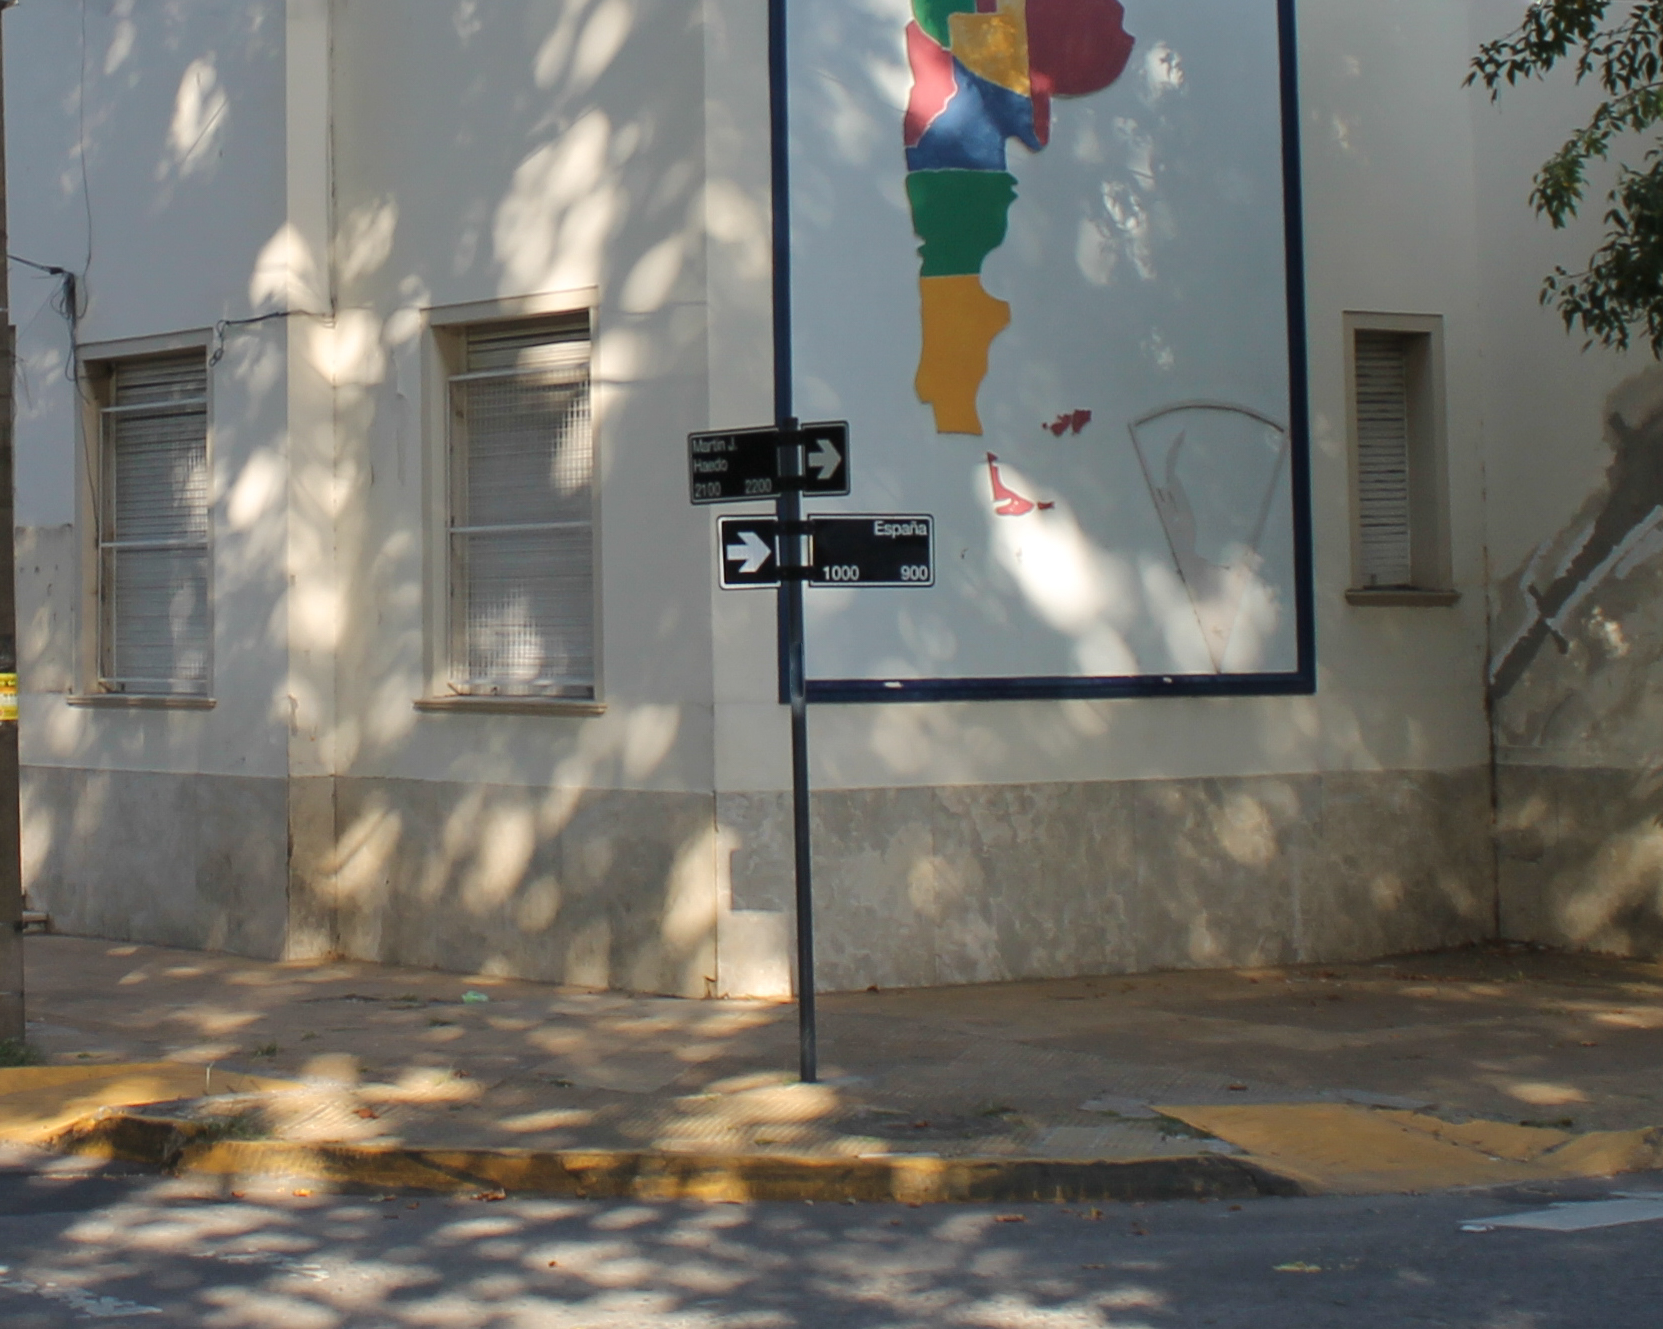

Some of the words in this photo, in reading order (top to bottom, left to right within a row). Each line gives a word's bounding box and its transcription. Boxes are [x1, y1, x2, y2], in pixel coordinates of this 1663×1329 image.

[695, 481, 722, 498] 2100
[745, 477, 773, 494] 2200
[873, 520, 928, 539] España
[822, 564, 860, 581] 1000
[900, 564, 929, 581] 900
